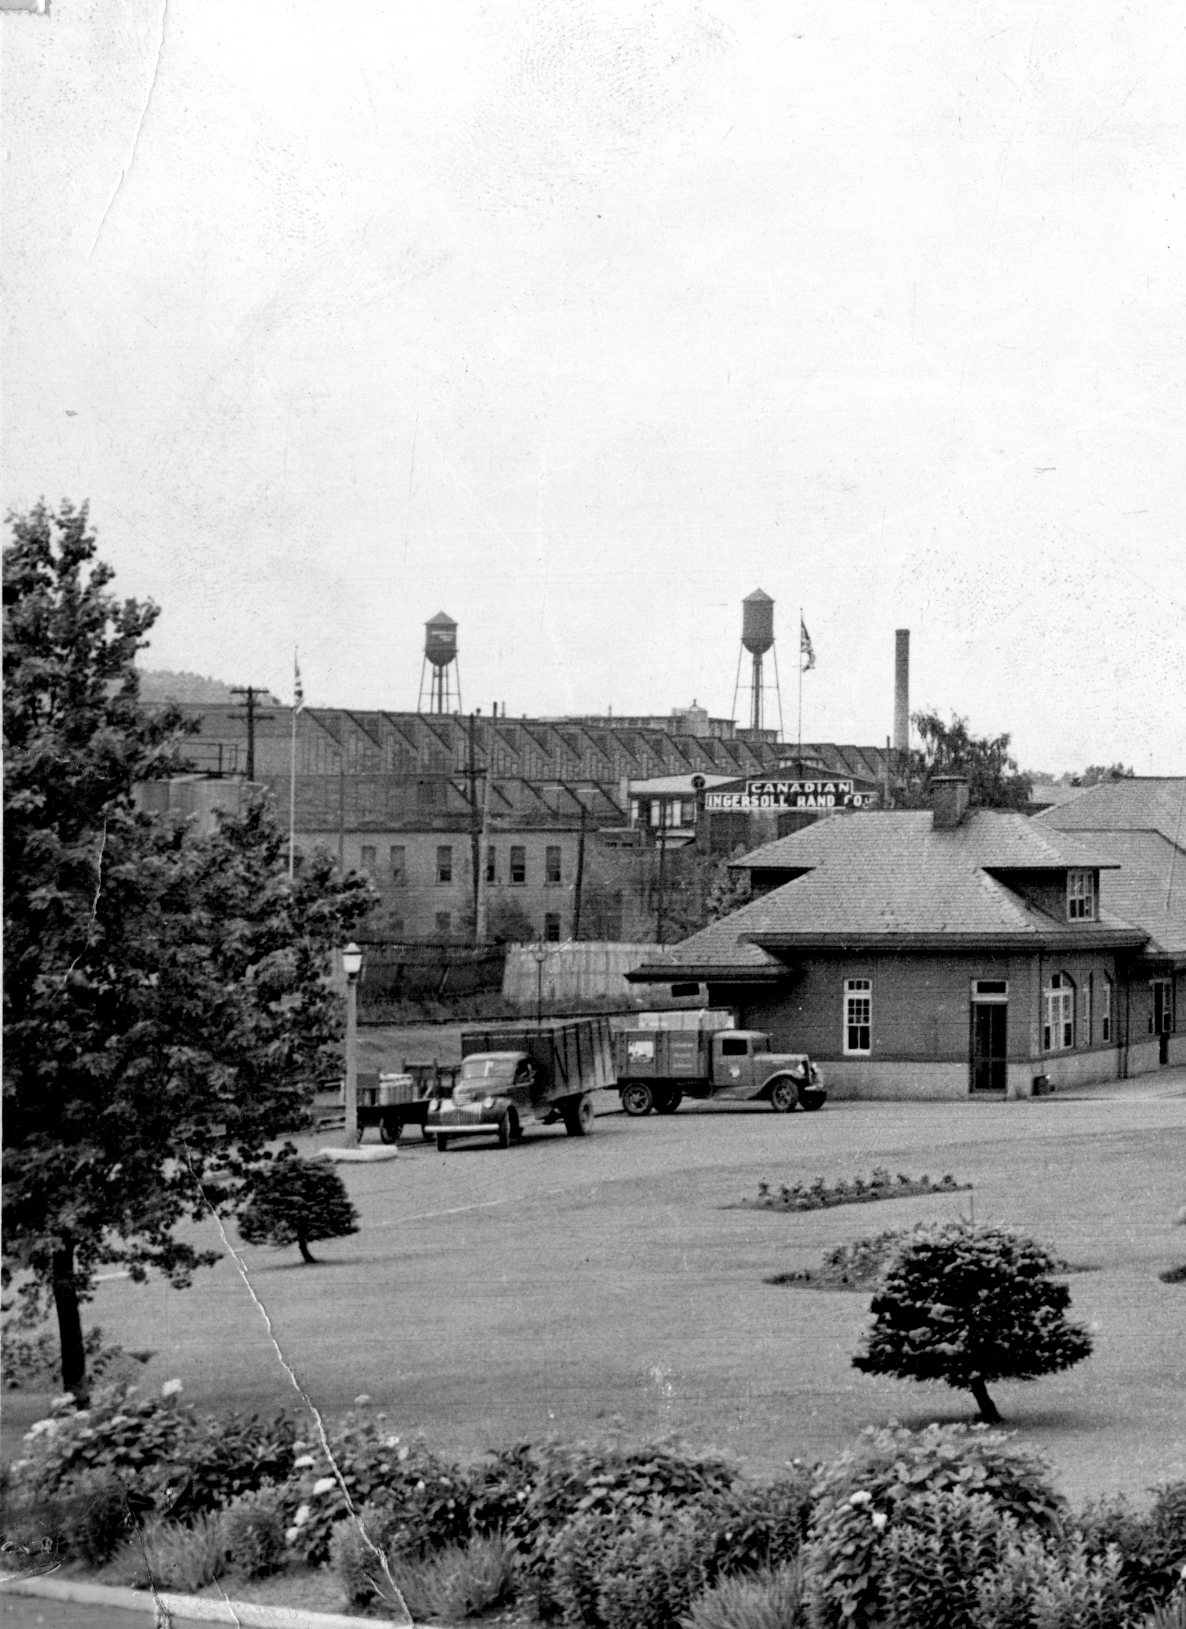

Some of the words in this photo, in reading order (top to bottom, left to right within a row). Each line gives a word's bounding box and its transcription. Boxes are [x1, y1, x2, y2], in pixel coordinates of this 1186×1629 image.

[751, 783, 850, 793] CANADIAN
[708, 795, 788, 807] INGERSOLL
[797, 795, 835, 807] RAND
